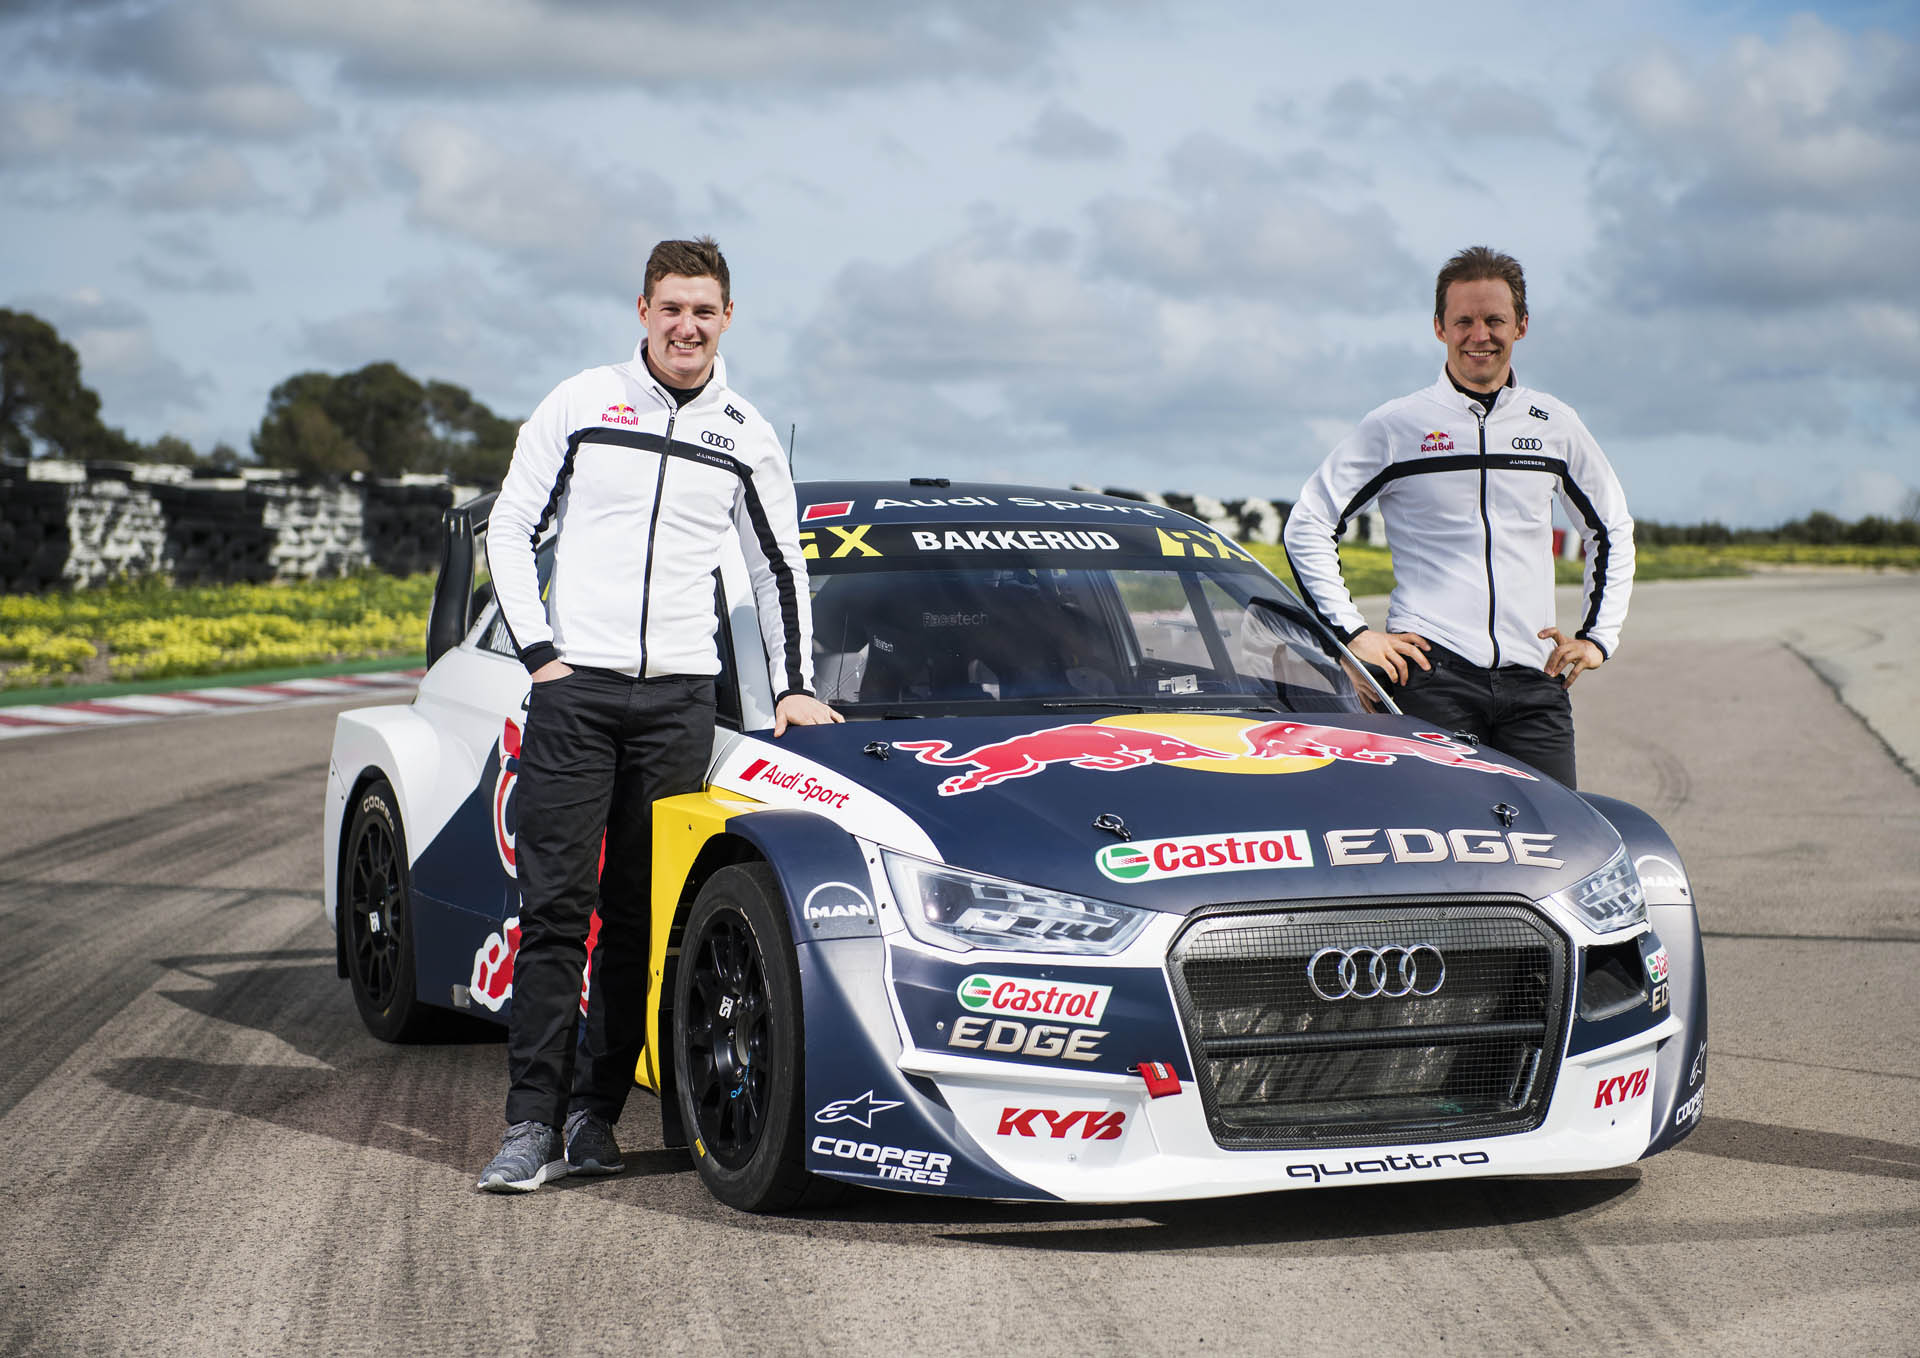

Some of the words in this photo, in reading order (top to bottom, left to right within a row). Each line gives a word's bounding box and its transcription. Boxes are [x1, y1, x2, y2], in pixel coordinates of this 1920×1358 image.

[601, 413, 620, 425] Red
[621, 415, 639, 426] Bull
[696, 452, 735, 467] J.LINDEBERG
[1420, 443, 1437, 452] Red
[1438, 441, 1454, 451] Bull
[1509, 459, 1546, 467] J.LINDEBERG
[874, 496, 999, 510] Audi
[1008, 496, 1165, 520] Sport
[911, 529, 1121, 552] BAKKERUD
[760, 764, 805, 791] Audi
[797, 777, 850, 809] Sport
[1152, 834, 1303, 873] Castrol
[1324, 828, 1567, 871] EDGE
[809, 904, 869, 919] MAN
[991, 981, 1099, 1019] Castrol
[947, 1016, 1111, 1062] EDGE
[1593, 1067, 1650, 1109] KYB
[996, 1106, 1127, 1141] KYB
[811, 1136, 953, 1173] COOPER
[1285, 1150, 1490, 1183] quattro
[876, 1164, 949, 1187] TIRES
